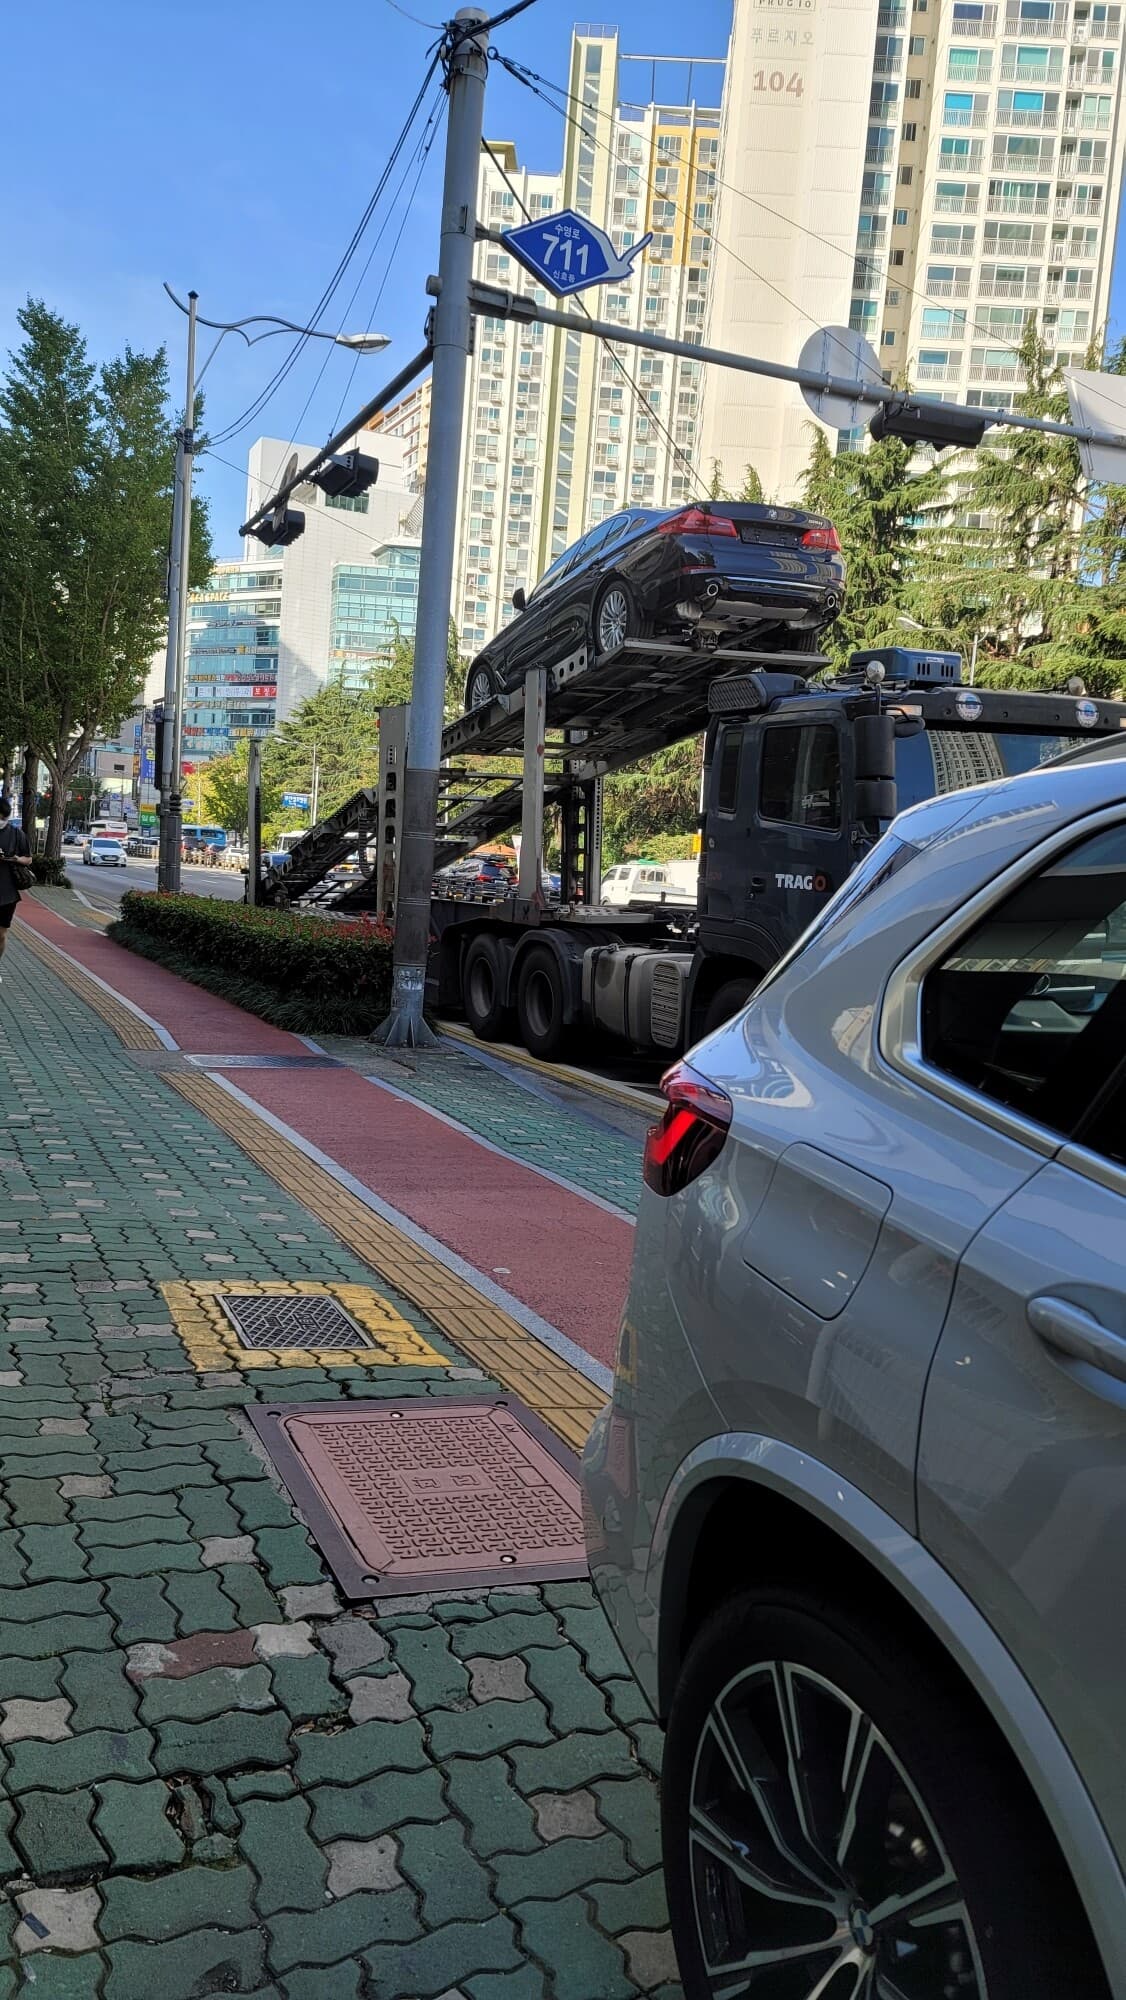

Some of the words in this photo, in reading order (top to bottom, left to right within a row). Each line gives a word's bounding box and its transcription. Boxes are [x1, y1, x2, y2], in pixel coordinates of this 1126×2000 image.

[751, 27, 814, 47] 푸르지오
[753, 70, 804, 98] 104
[554, 223, 581, 240] 수영로
[542, 232, 589, 276] 711
[552, 269, 576, 283] 신호등
[775, 873, 826, 892] TRAGO
